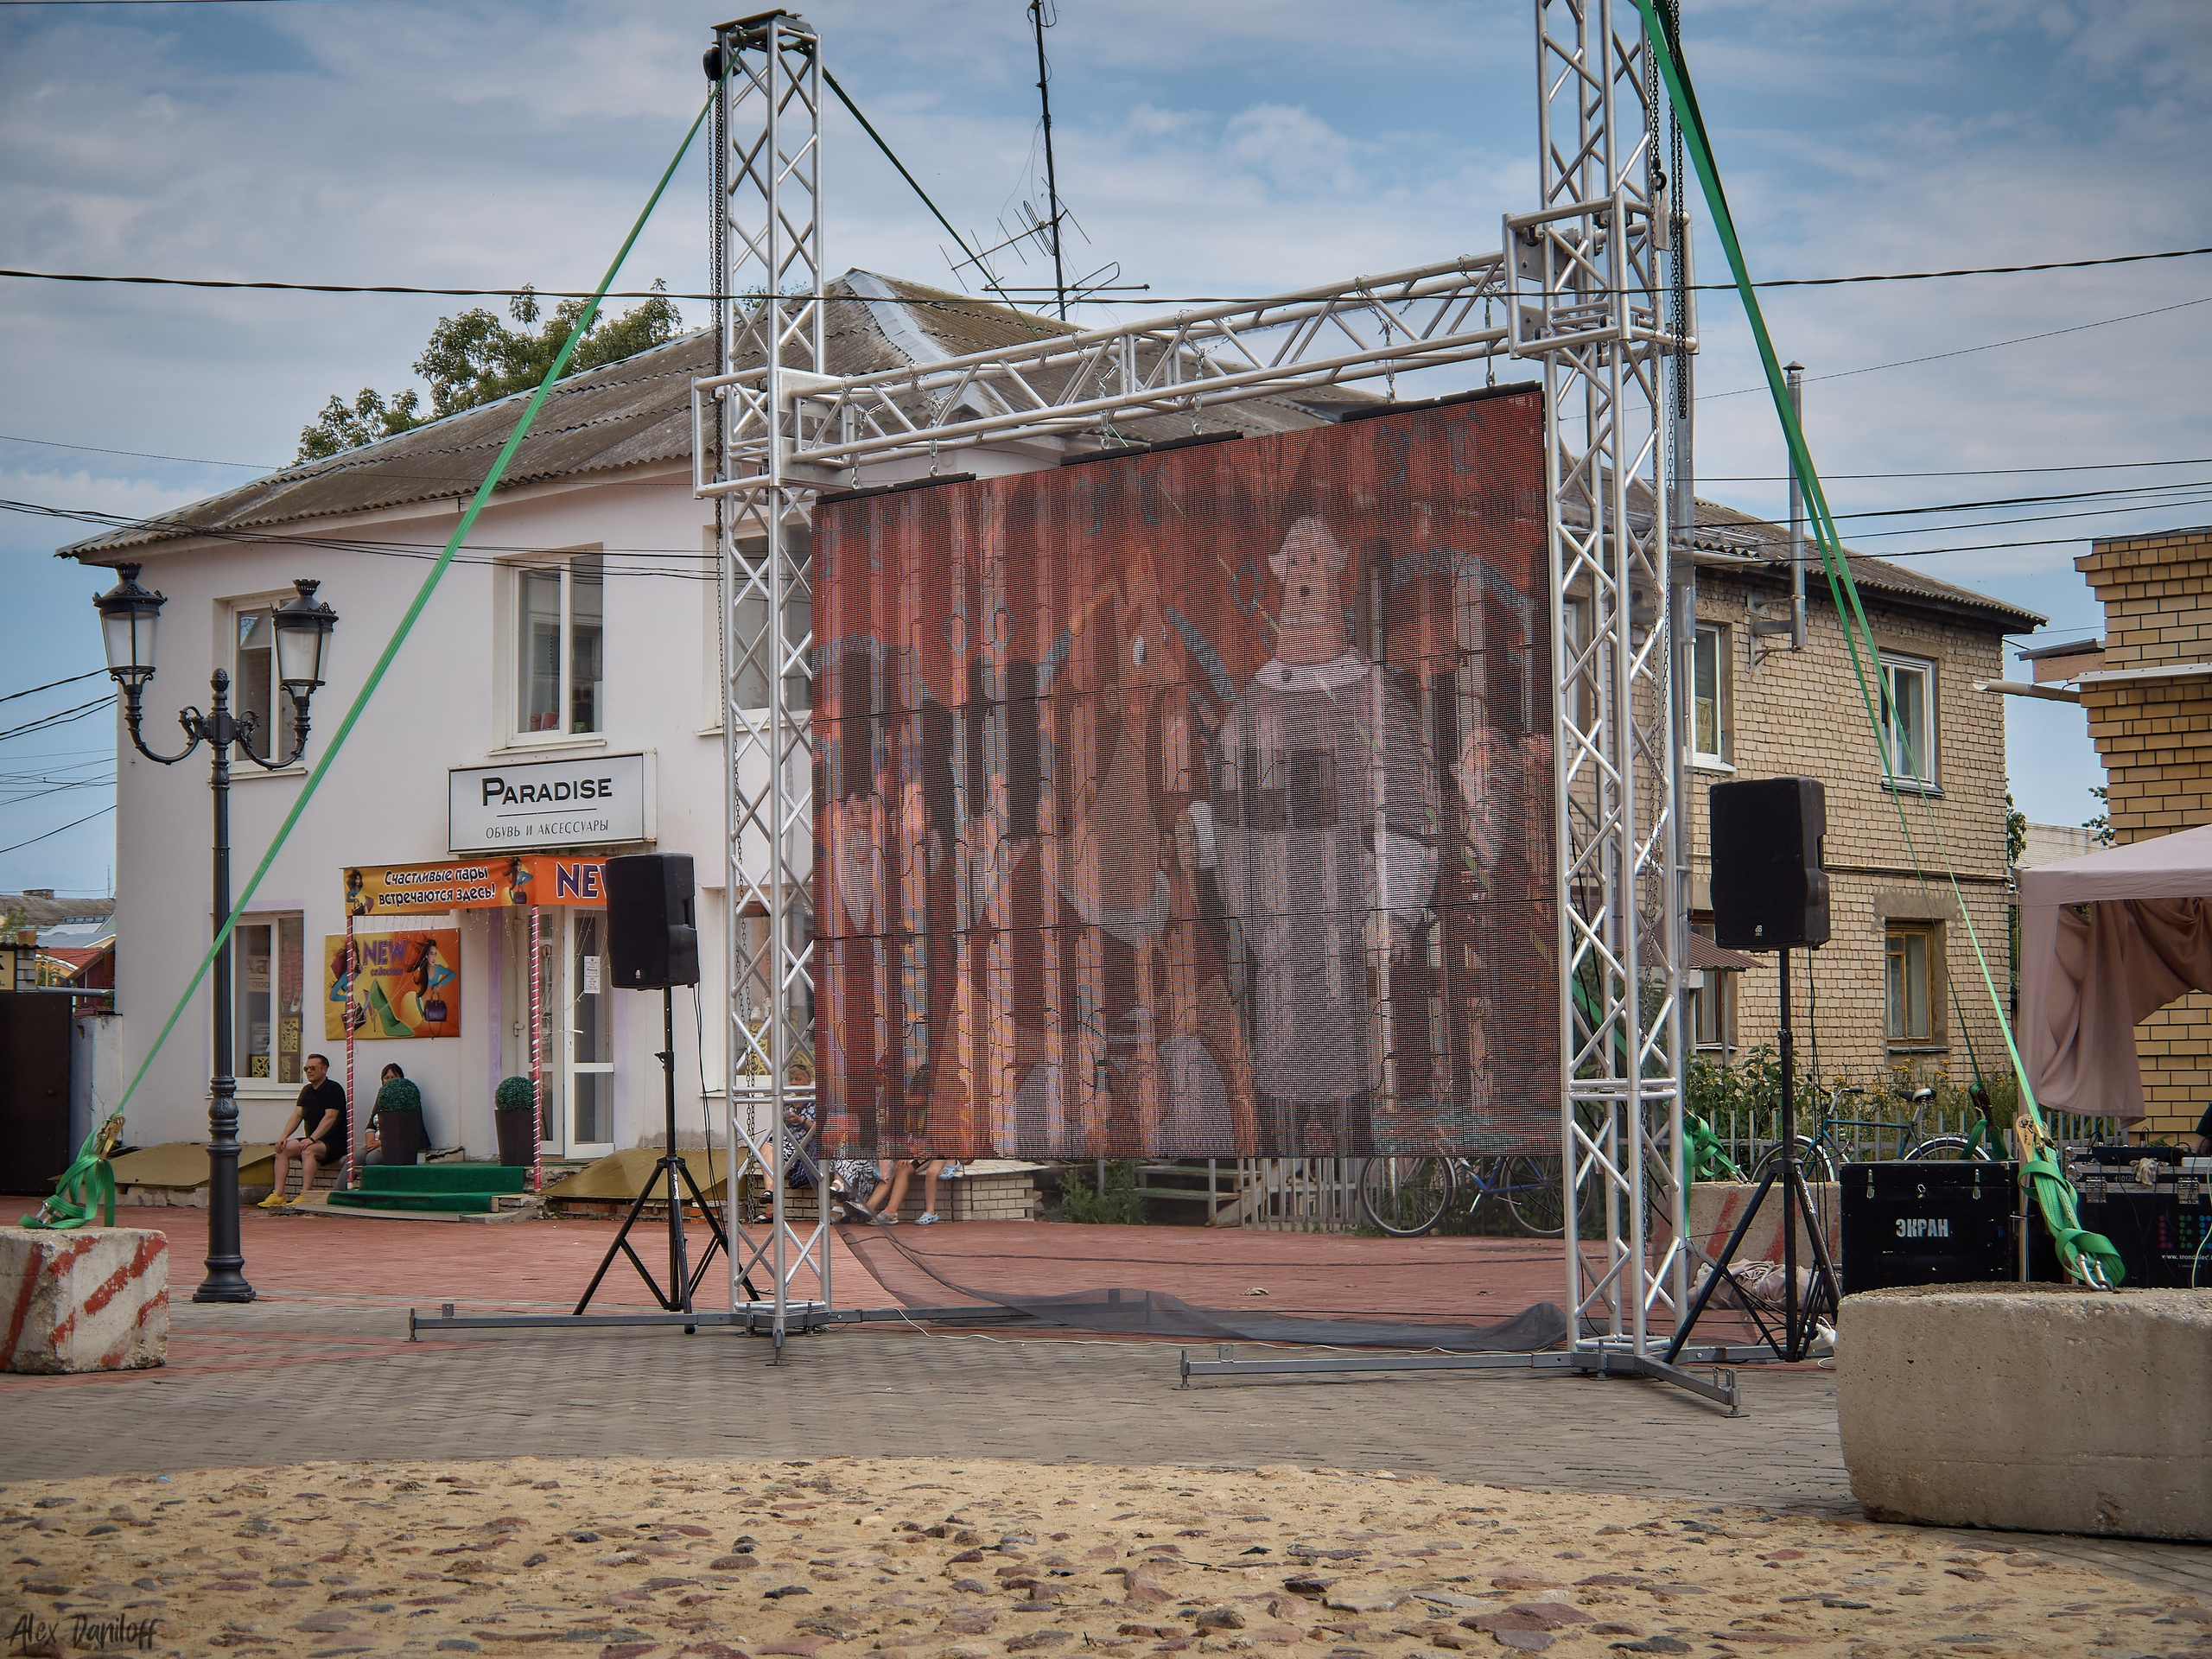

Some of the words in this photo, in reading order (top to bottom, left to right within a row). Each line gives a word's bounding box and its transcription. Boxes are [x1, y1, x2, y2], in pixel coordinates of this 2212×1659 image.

[486, 826, 520, 840] ОБУВЬ
[525, 825, 532, 836] И
[537, 819, 608, 836] АКСЕССУАРЫ
[385, 869, 453, 886] Счастливые
[455, 867, 488, 883] пары
[556, 861, 607, 899] NE
[378, 888, 454, 908] встречаются
[456, 882, 496, 902] здесь!
[362, 938, 407, 966] NEW
[1895, 1218, 1948, 1237] ЭКРАН
